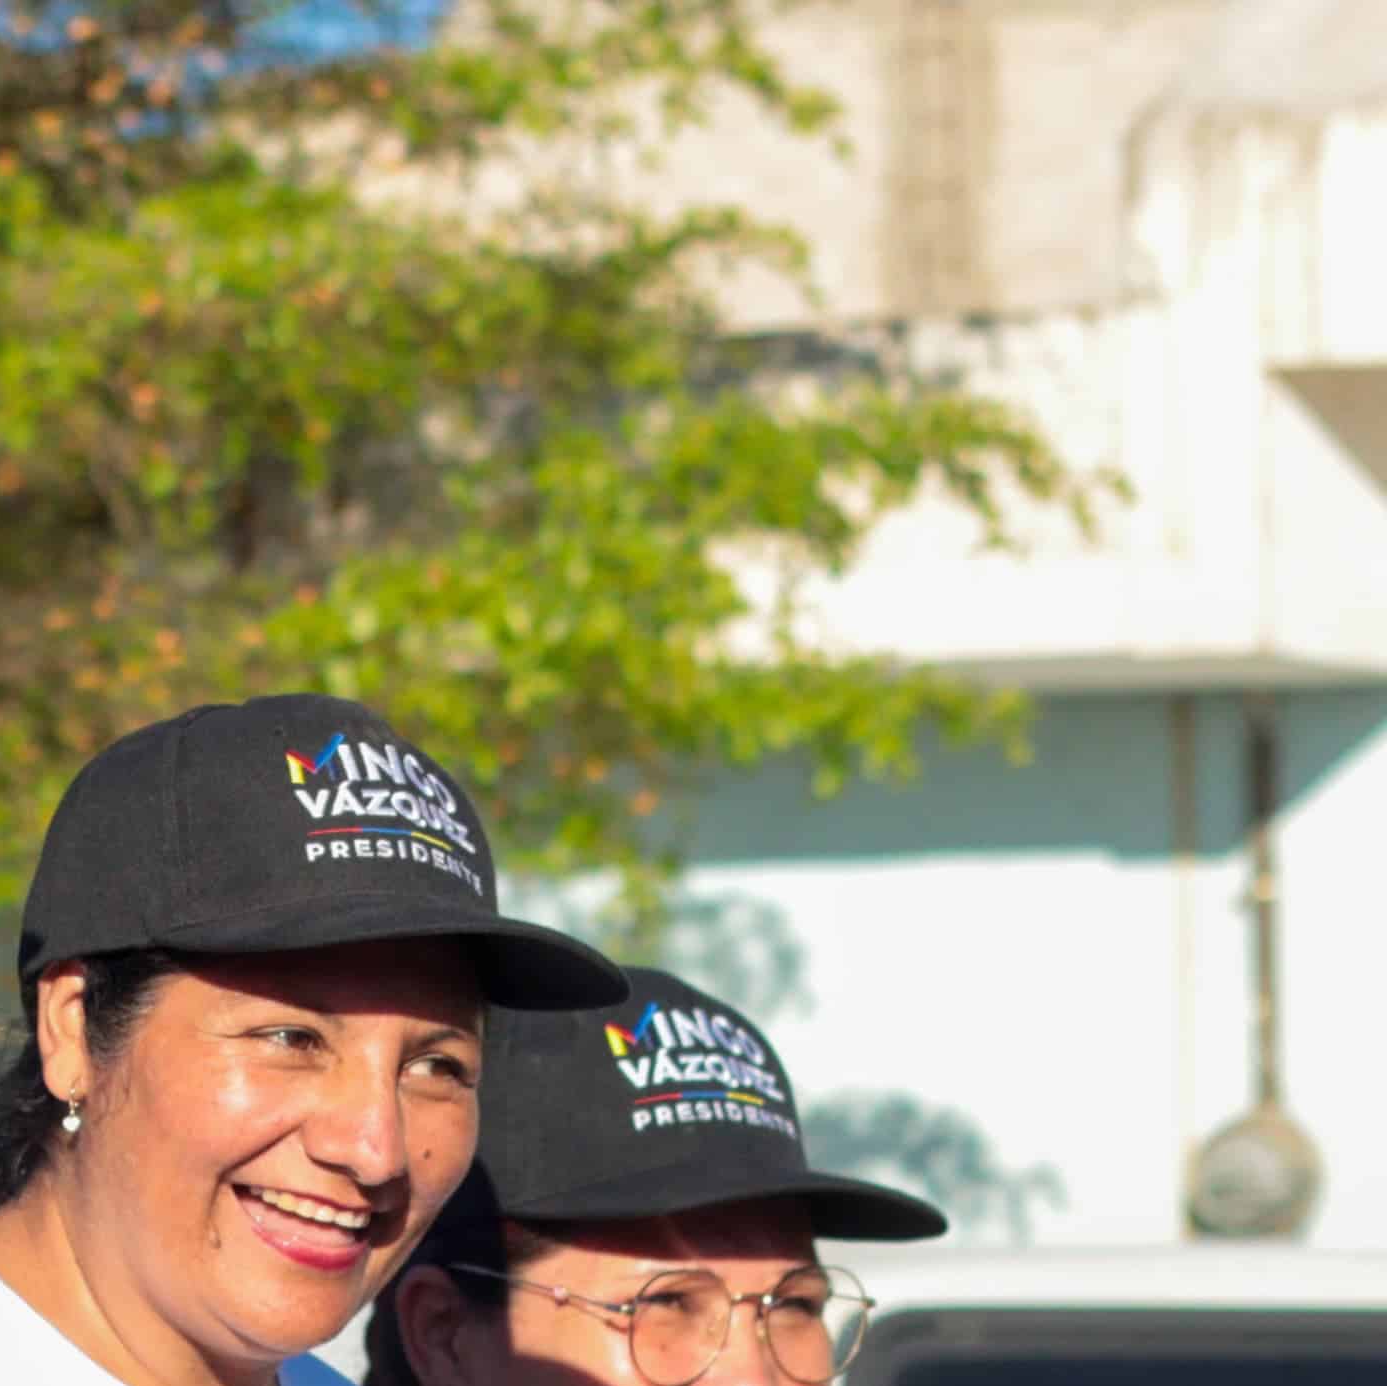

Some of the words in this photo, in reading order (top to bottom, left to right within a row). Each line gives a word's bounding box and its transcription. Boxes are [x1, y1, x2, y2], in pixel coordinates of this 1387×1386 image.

[285, 732, 456, 814] MINGO
[294, 779, 476, 854] VÁZQUEZ
[305, 838, 482, 895] PRESIDENTE
[604, 1001, 765, 1066] MINGO
[618, 1047, 785, 1101] VÁZQUEZ
